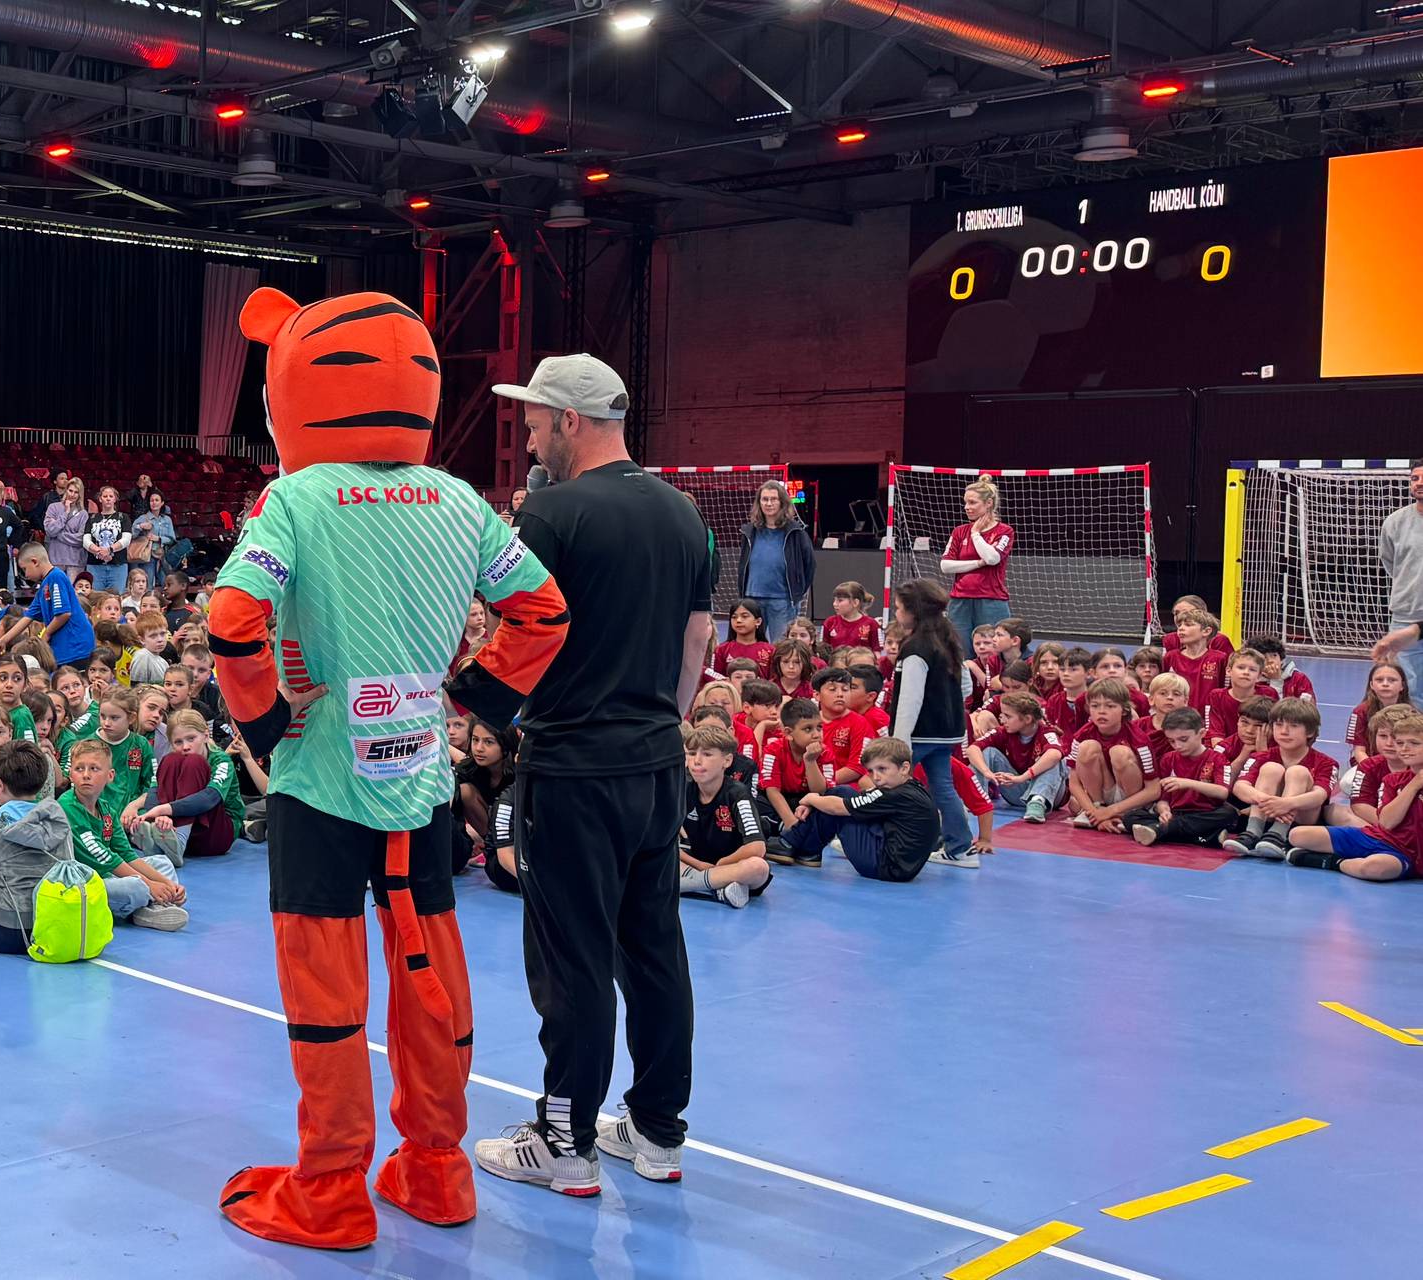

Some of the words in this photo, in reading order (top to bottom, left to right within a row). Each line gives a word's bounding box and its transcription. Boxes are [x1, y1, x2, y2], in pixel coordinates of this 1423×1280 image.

[1078, 199, 1088, 224] 1
[1149, 187, 1196, 213] HANDBALL
[1200, 179, 1225, 208] KÖLN
[965, 206, 1023, 231] GRUNDSCHULLIGA
[1021, 237, 1150, 278] 00:00
[1201, 245, 1231, 282] 0
[950, 267, 975, 300] 0
[336, 486, 379, 506] LSC
[383, 482, 440, 505] KÖLN
[491, 552, 522, 583] Sascha
